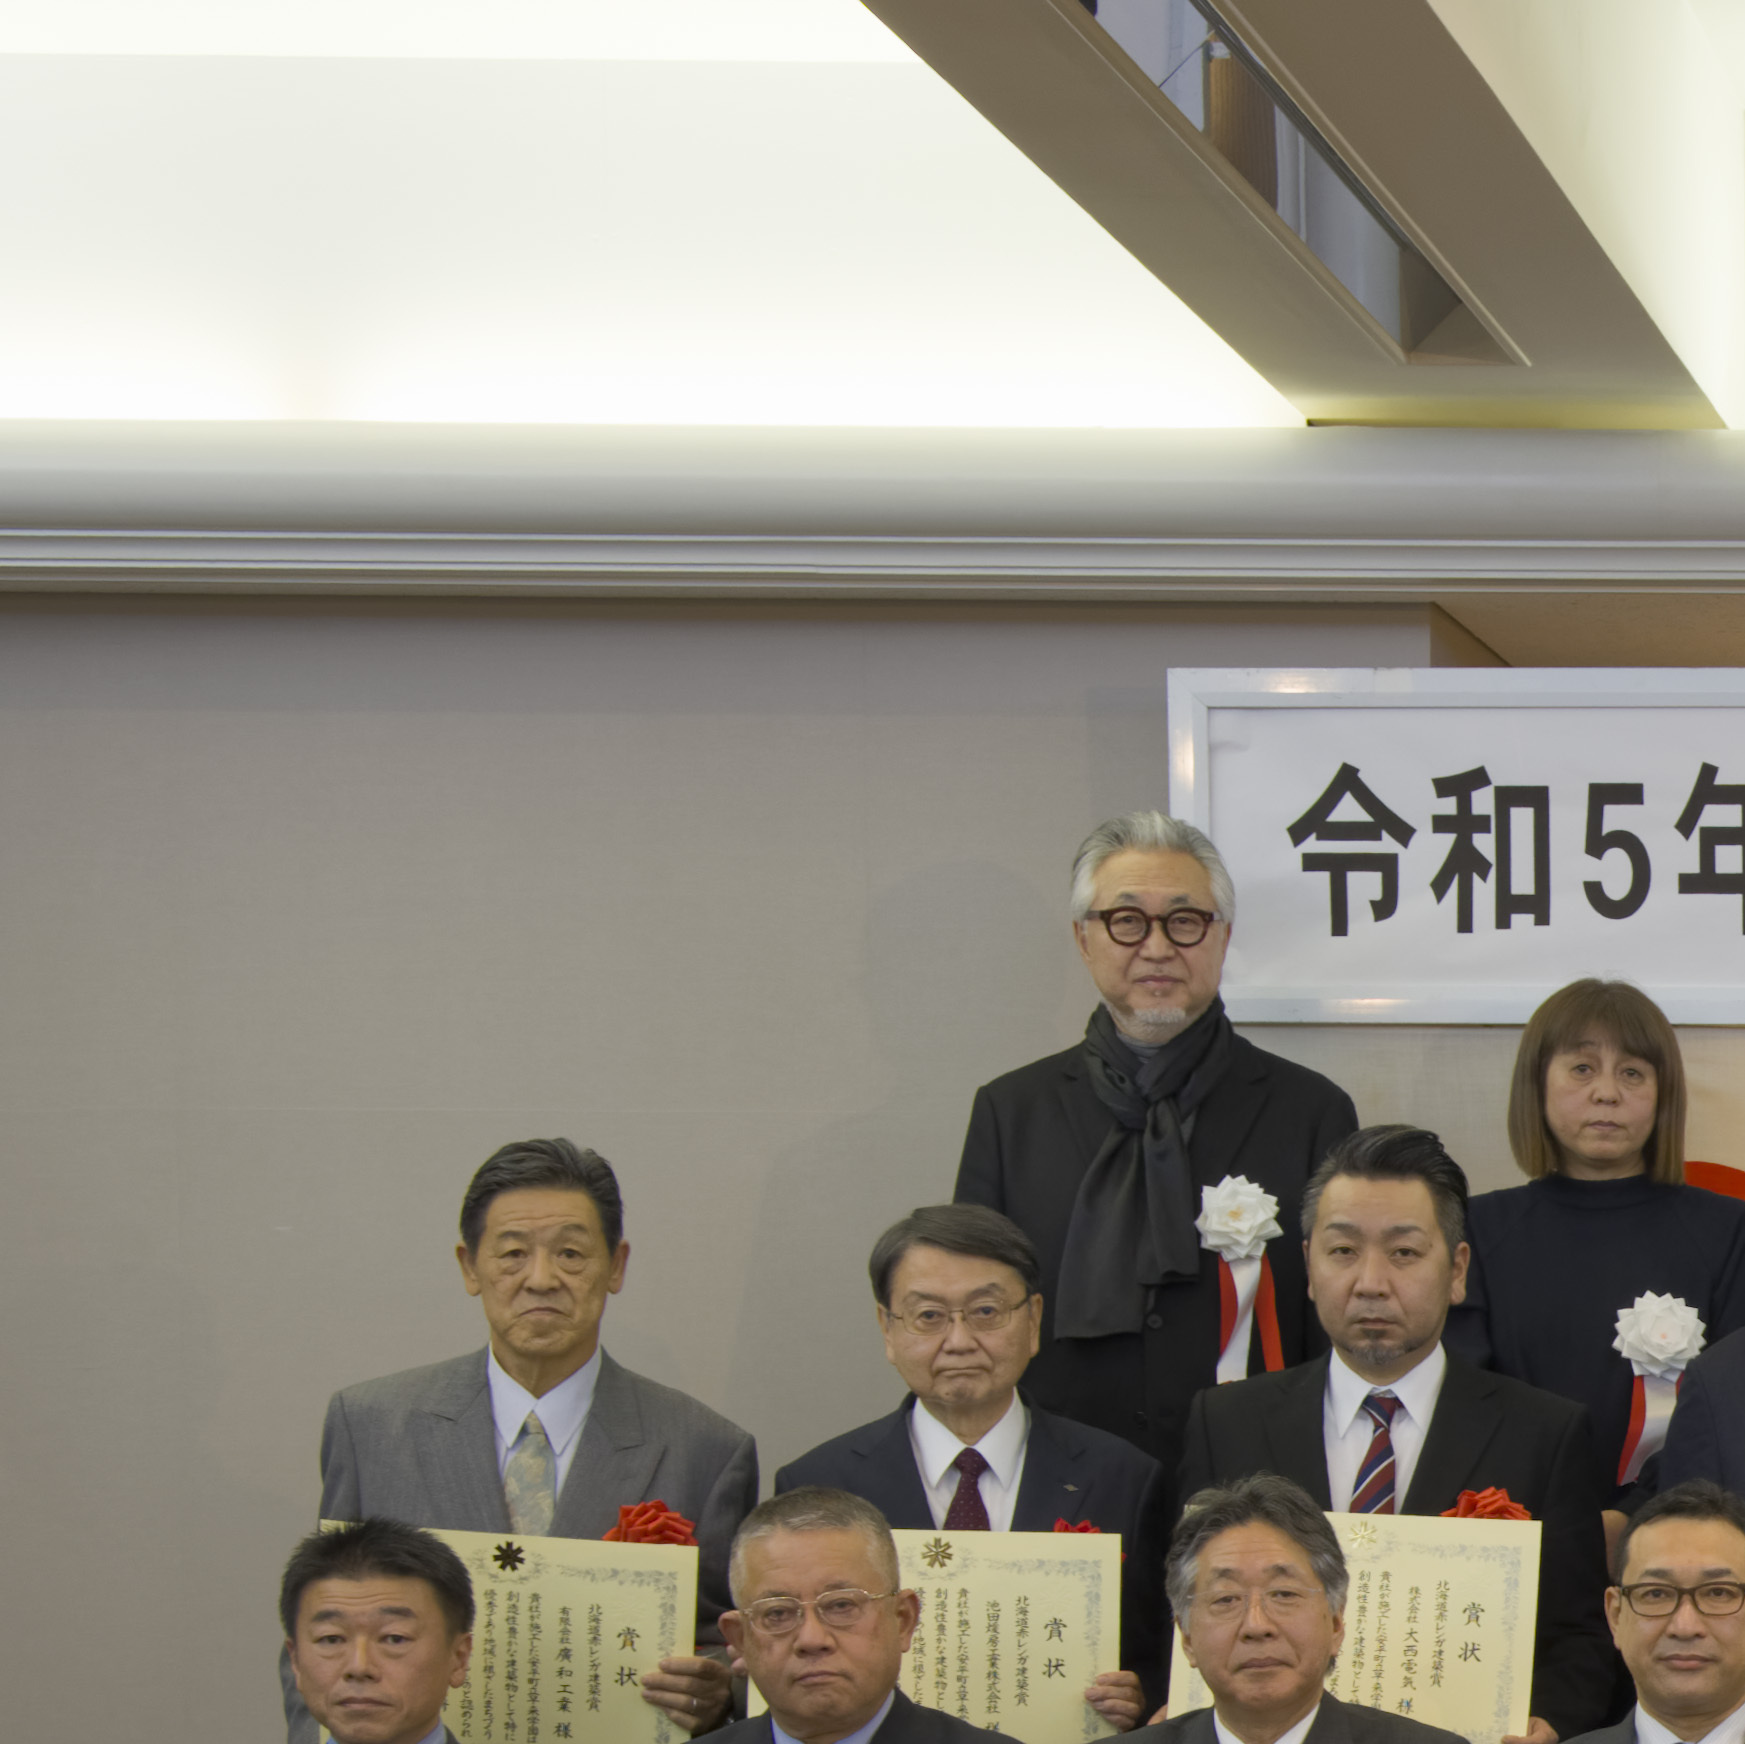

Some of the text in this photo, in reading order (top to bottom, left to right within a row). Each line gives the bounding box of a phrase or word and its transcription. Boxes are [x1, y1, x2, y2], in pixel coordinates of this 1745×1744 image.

[586, 1604, 603, 1712] 北海道赤レンガ建築賞
[614, 1626, 641, 1687] 賞状
[1014, 1595, 1030, 1706] 北海道赤レンガ建築賞
[1042, 1617, 1068, 1679] 賞状
[1430, 1580, 1450, 1688] 北海道赤レンガ建築賞
[1458, 1602, 1485, 1662] 賞状
